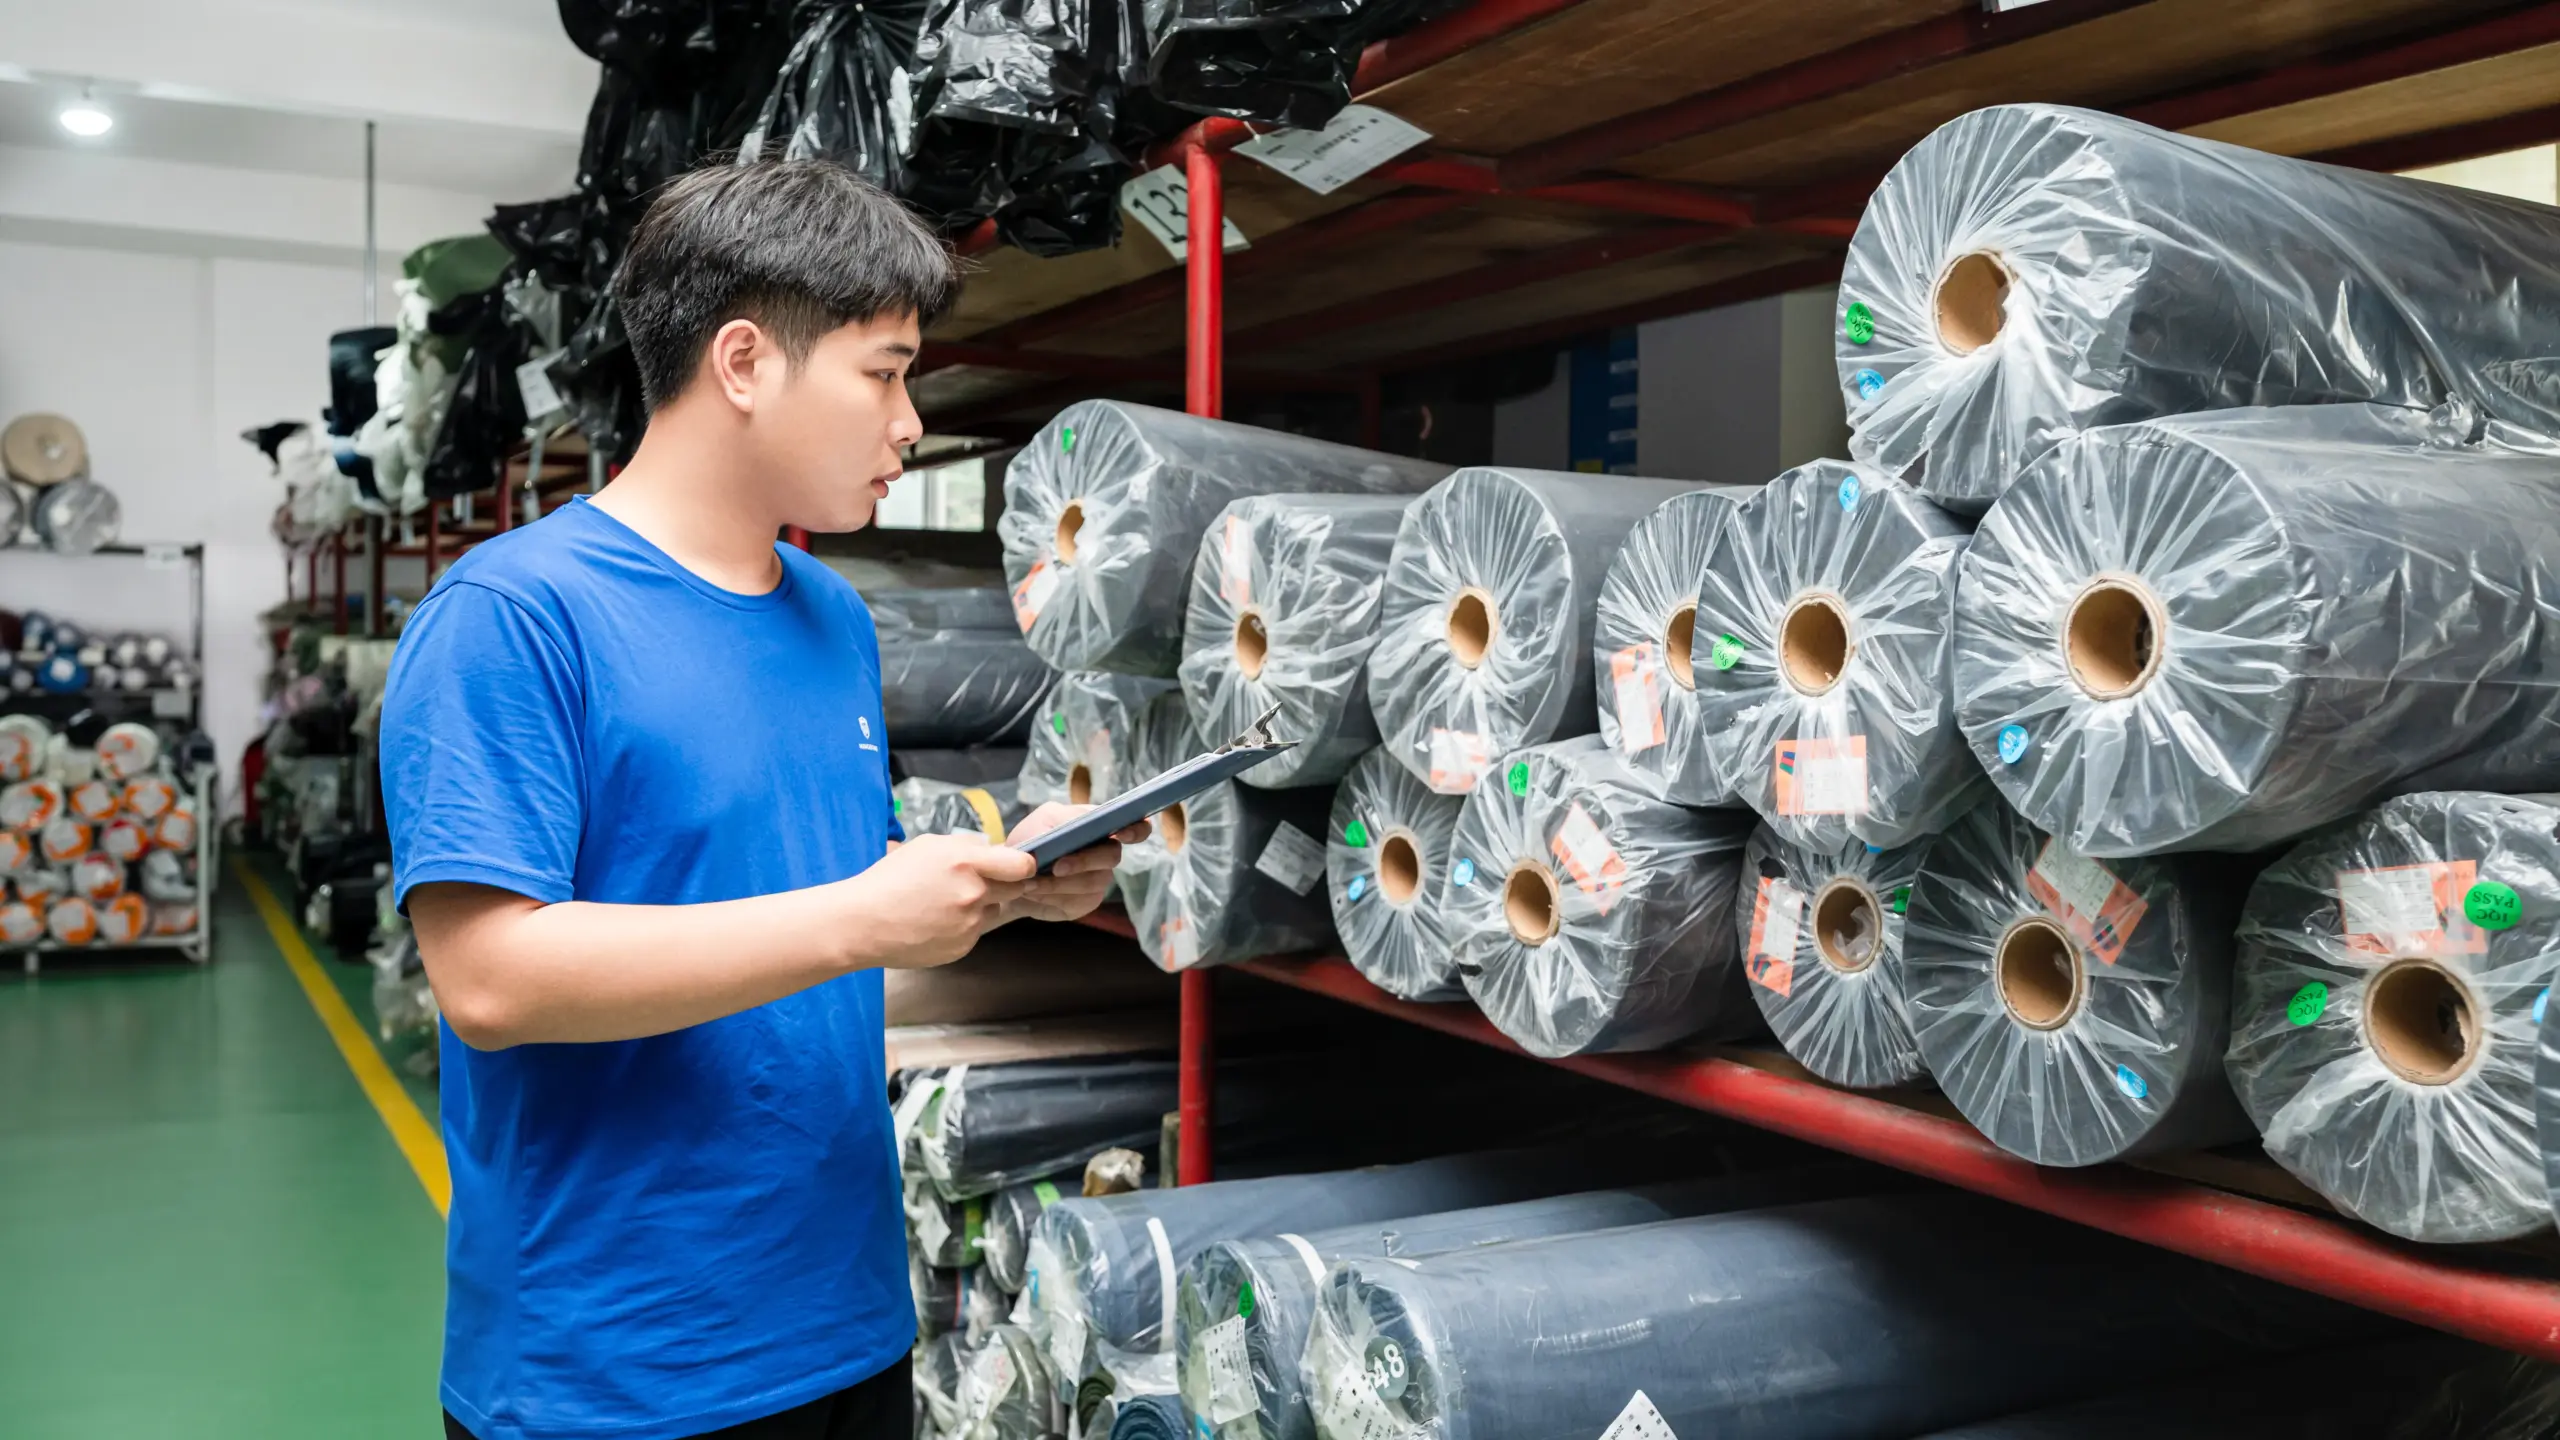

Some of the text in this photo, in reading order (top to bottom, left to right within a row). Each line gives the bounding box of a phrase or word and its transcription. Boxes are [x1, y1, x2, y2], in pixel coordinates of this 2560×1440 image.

[2472, 890, 2516, 909] PASS
[2476, 908, 2509, 923] IQC
[2294, 989, 2324, 1005] PASS
[2295, 1003, 2318, 1019] IQC
